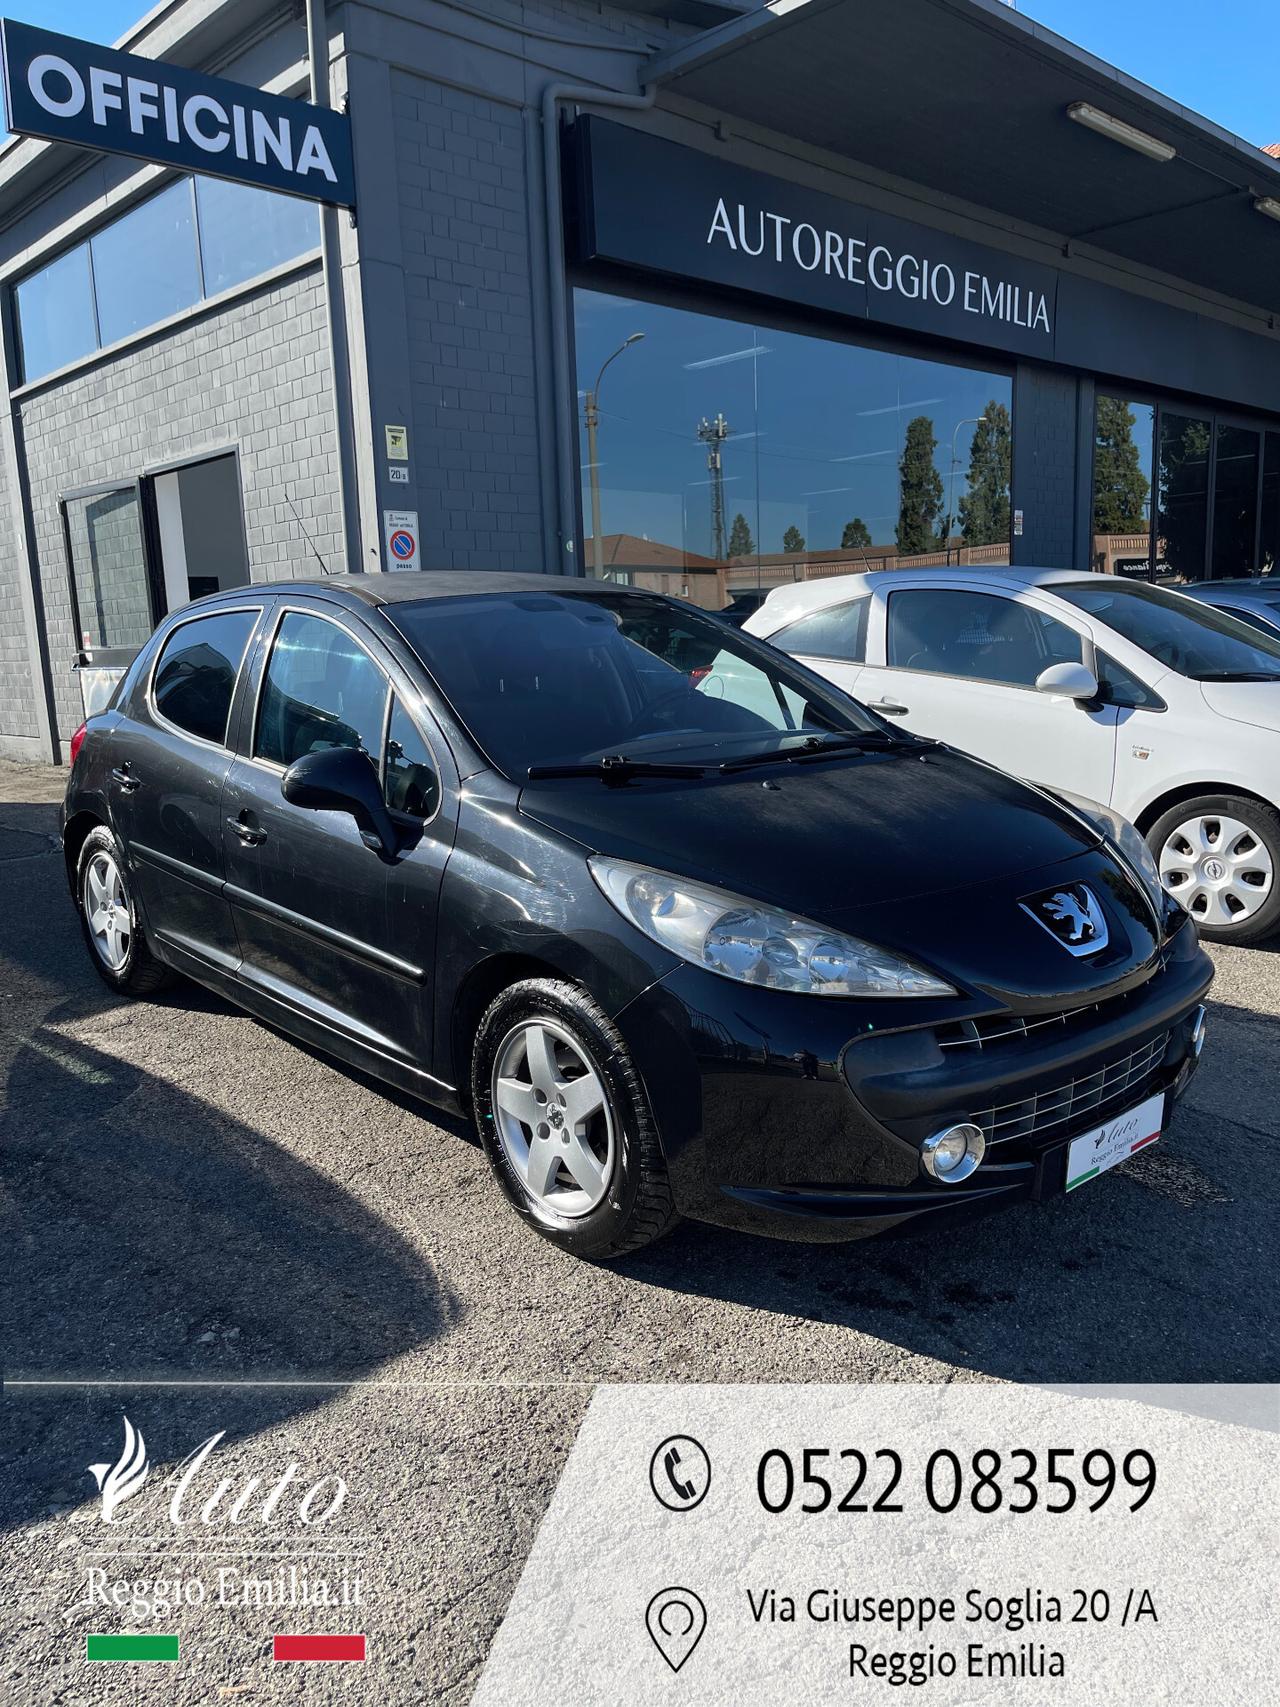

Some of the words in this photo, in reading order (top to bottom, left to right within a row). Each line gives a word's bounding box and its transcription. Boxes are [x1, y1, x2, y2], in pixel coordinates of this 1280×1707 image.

[27, 54, 338, 183] OFFICINA
[707, 198, 955, 305] AUTOREGGIO
[964, 271, 1050, 333] EMILIA
[391, 470, 401, 480] 20
